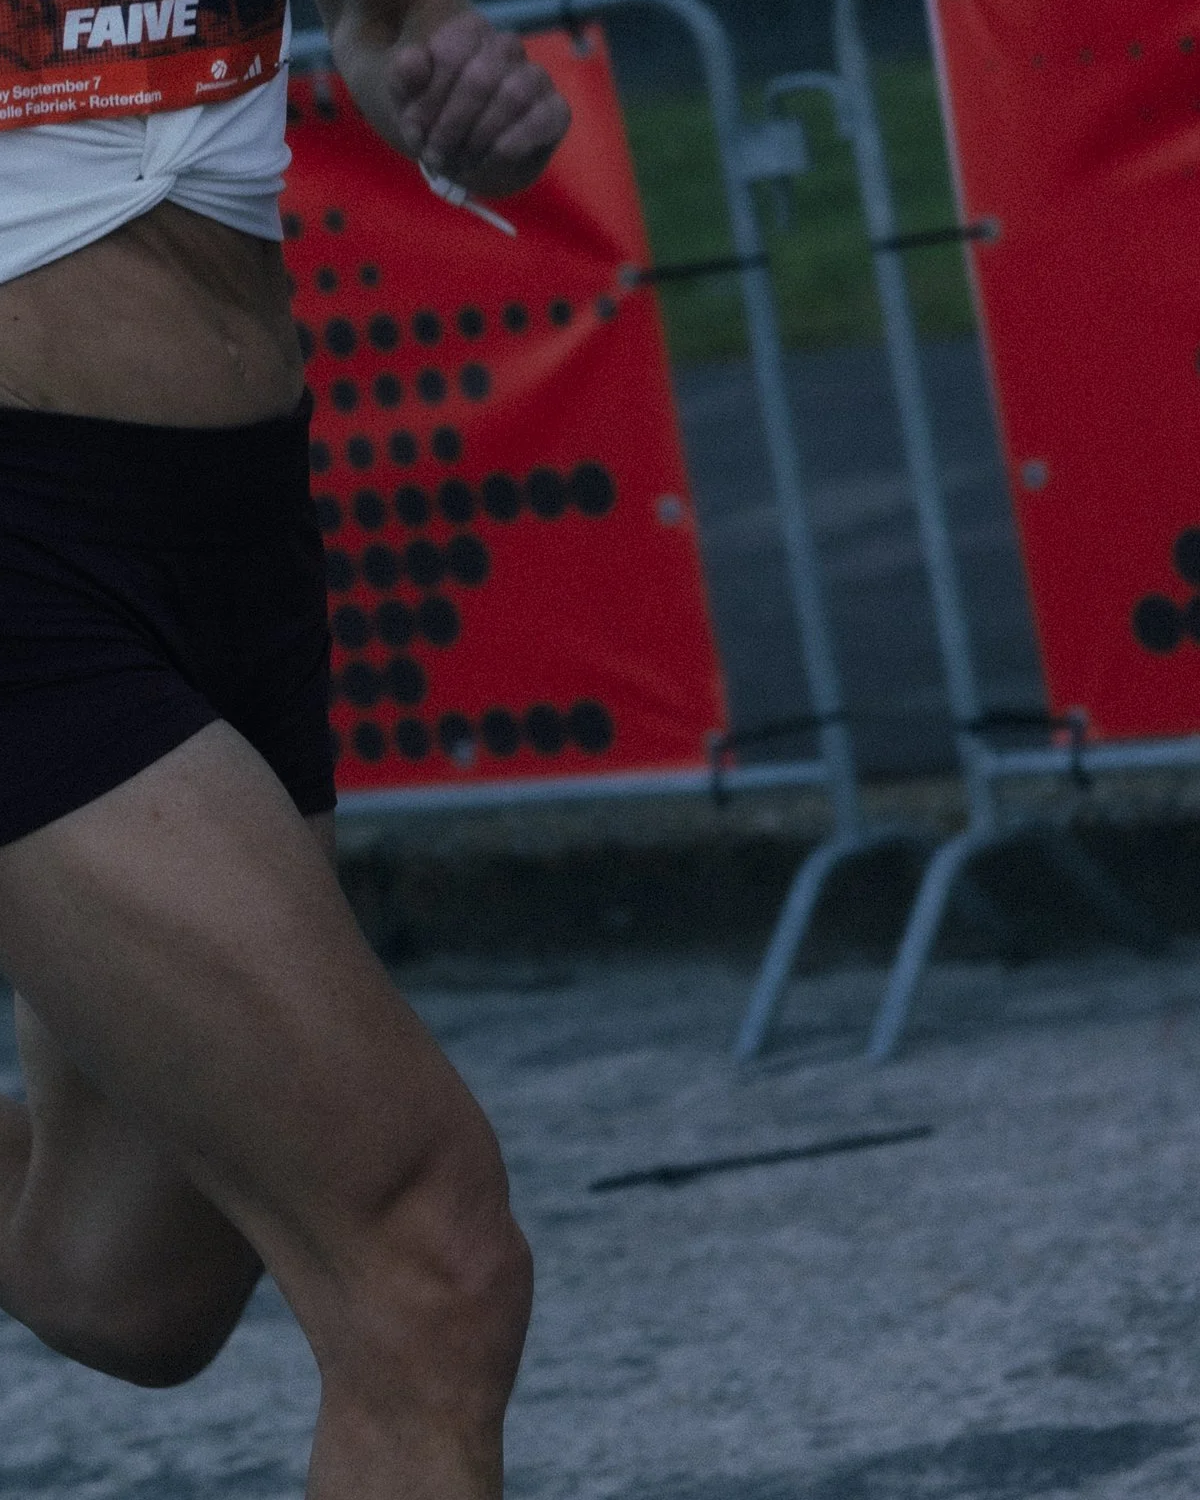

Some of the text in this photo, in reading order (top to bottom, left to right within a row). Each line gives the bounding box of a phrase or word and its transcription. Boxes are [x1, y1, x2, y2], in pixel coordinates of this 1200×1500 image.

[12, 79, 90, 101] September
[92, 76, 102, 91] 7
[25, 98, 77, 117] Fabriek
[89, 90, 163, 109] Rotterdam
